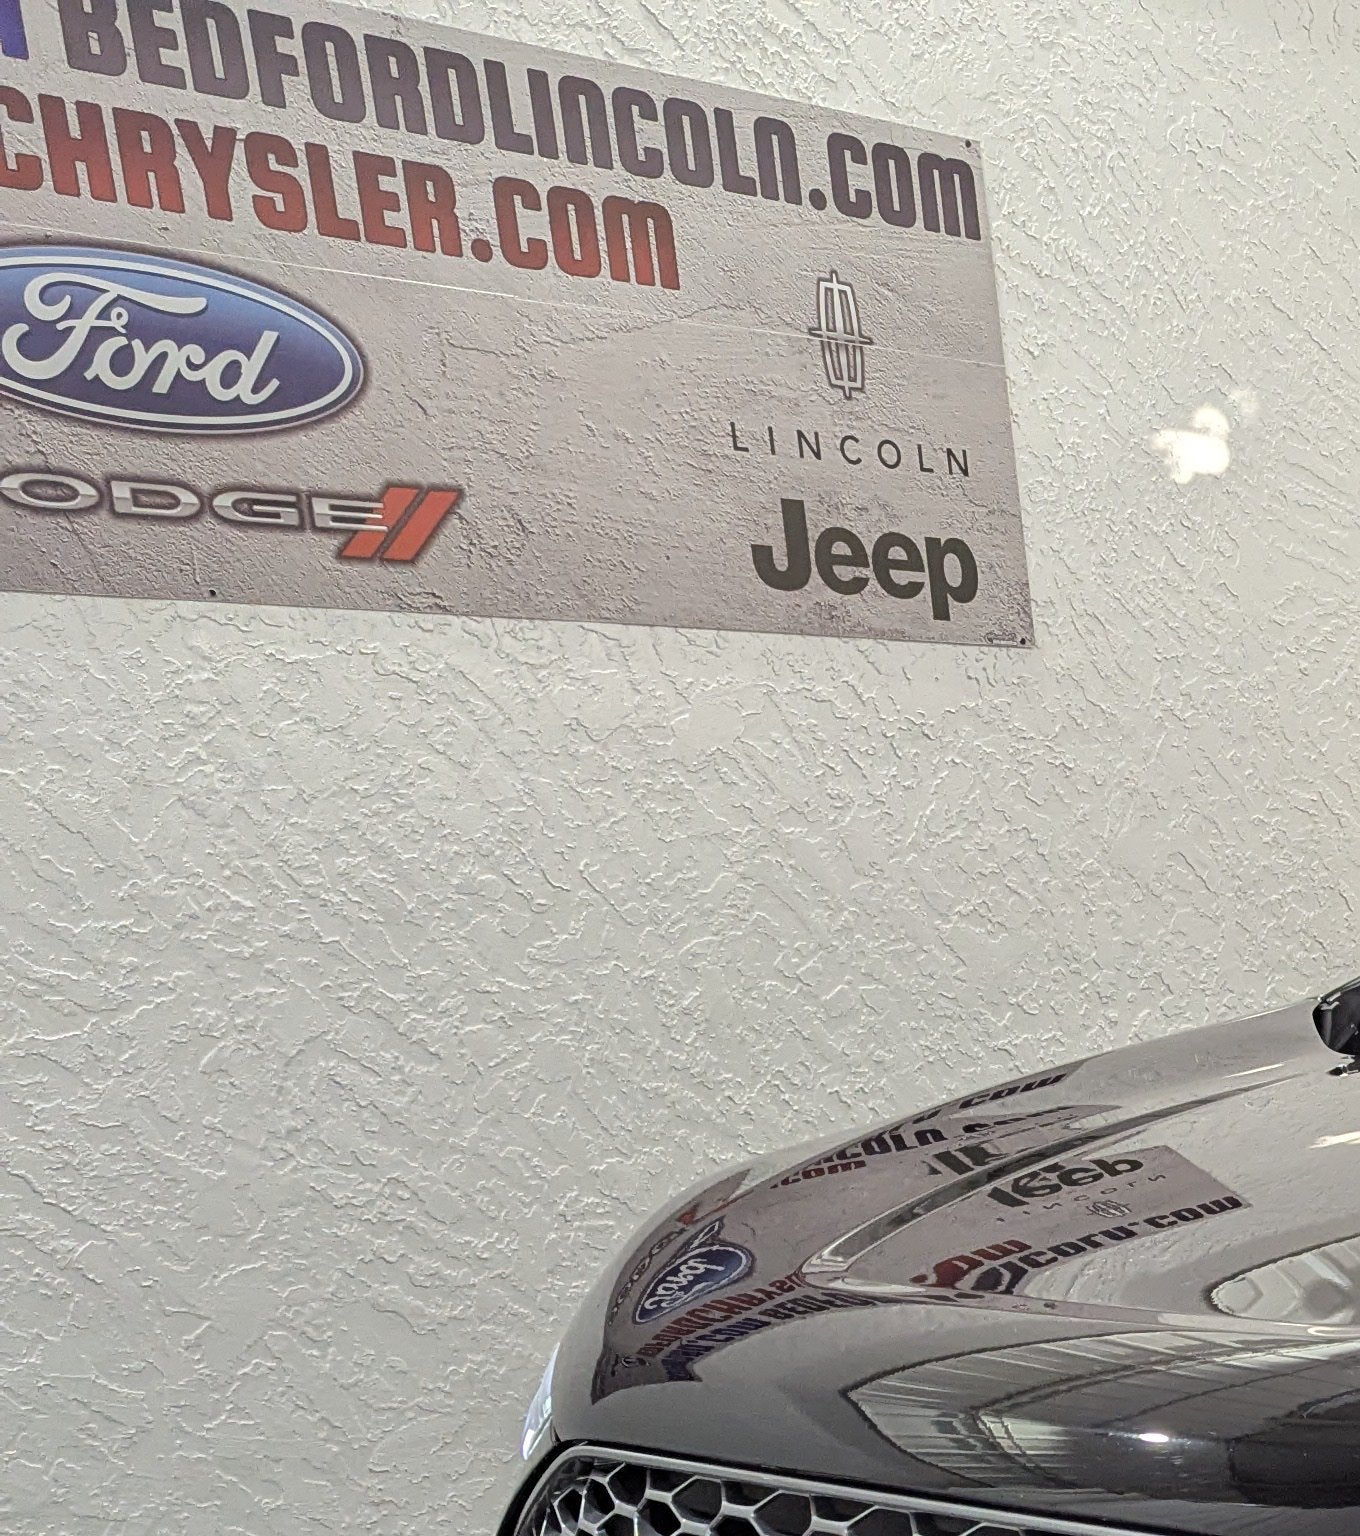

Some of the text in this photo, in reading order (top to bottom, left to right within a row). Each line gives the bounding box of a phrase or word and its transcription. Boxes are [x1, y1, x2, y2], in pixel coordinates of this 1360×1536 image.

[1, 272, 281, 405] Ford
[730, 421, 970, 477] LINCOLN
[751, 498, 979, 621] Jeep
